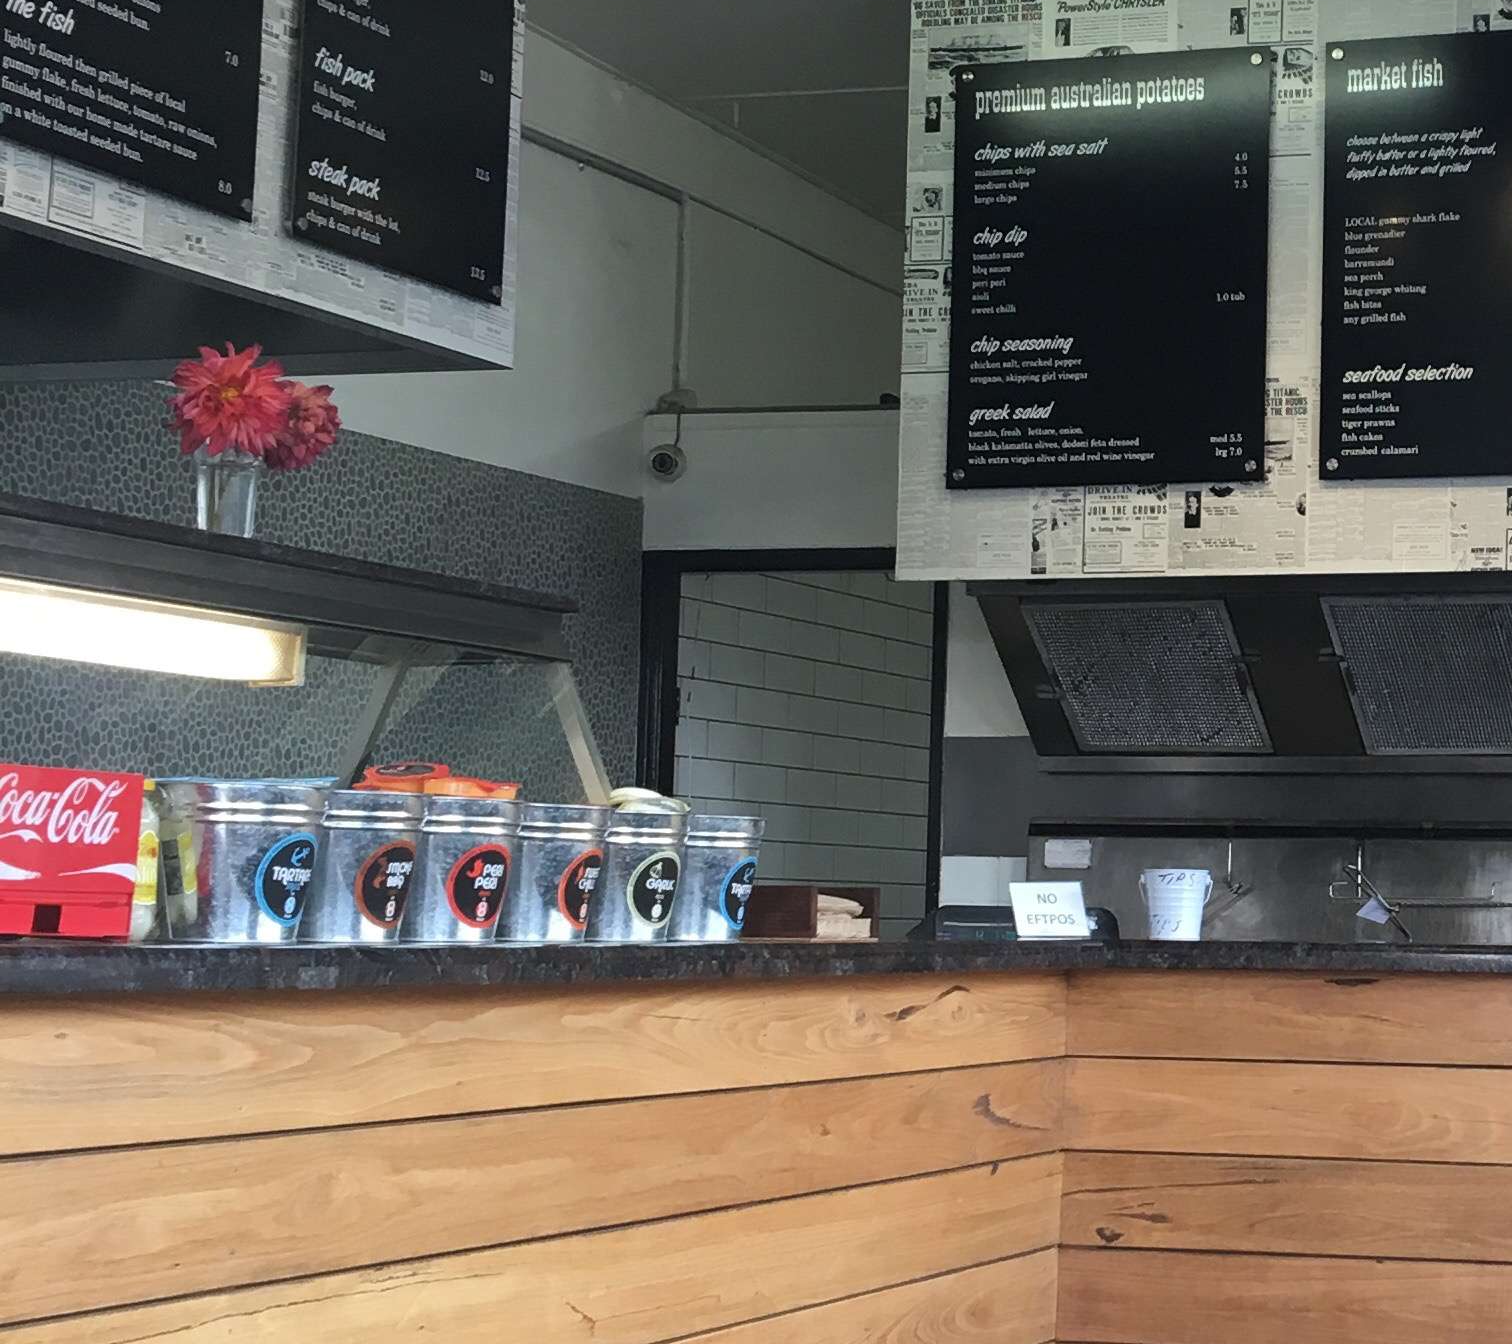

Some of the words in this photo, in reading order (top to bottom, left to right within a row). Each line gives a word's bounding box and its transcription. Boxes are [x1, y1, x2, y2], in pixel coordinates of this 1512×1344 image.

[38, 0, 75, 36] fish
[4, 28, 37, 56] lightly
[38, 44, 74, 68] floured
[75, 56, 97, 78] then
[98, 66, 129, 91] grilled
[313, 46, 343, 77] fish
[341, 66, 376, 93] pack
[1347, 61, 1407, 94] market
[1411, 57, 1444, 89] fish
[1, 75, 42, 101] finished
[44, 89, 66, 111] with
[975, 83, 1047, 120] premium
[1050, 78, 1132, 111] australian
[1135, 76, 1205, 110] potatoes
[974, 142, 1011, 164] chips
[1013, 139, 1047, 159] with
[1048, 142, 1074, 157] sea
[1076, 137, 1109, 156] salt
[217, 179, 232, 195] 8.0
[309, 158, 349, 188] steak
[346, 177, 382, 201] pack
[1345, 217, 1377, 228] LOCAL
[1378, 216, 1410, 227] gummy
[1412, 213, 1437, 223] shark
[1438, 212, 1460, 222] flake
[972, 227, 1002, 248] chip
[1004, 224, 1028, 244] dip
[970, 335, 1000, 356] chip
[1001, 335, 1074, 356] seasoning
[970, 359, 1001, 370] chicken
[1054, 357, 1083, 370] pepper
[1342, 364, 1403, 384] seafood
[1404, 362, 1474, 382] selection
[968, 404, 1010, 425] greek
[1013, 401, 1055, 421] salad
[1341, 418, 1362, 429] tiger
[1363, 418, 1395, 429] prawns
[1209, 433, 1228, 443] med
[1215, 447, 1228, 458] lrg
[1229, 447, 1243, 456] 7.0
[1340, 445, 1378, 456] crumbed
[1380, 444, 1419, 455] calamari
[1158, 872, 1196, 886] TIPS
[1037, 893, 1058, 905] NO
[1026, 913, 1076, 925] EFTPOS
